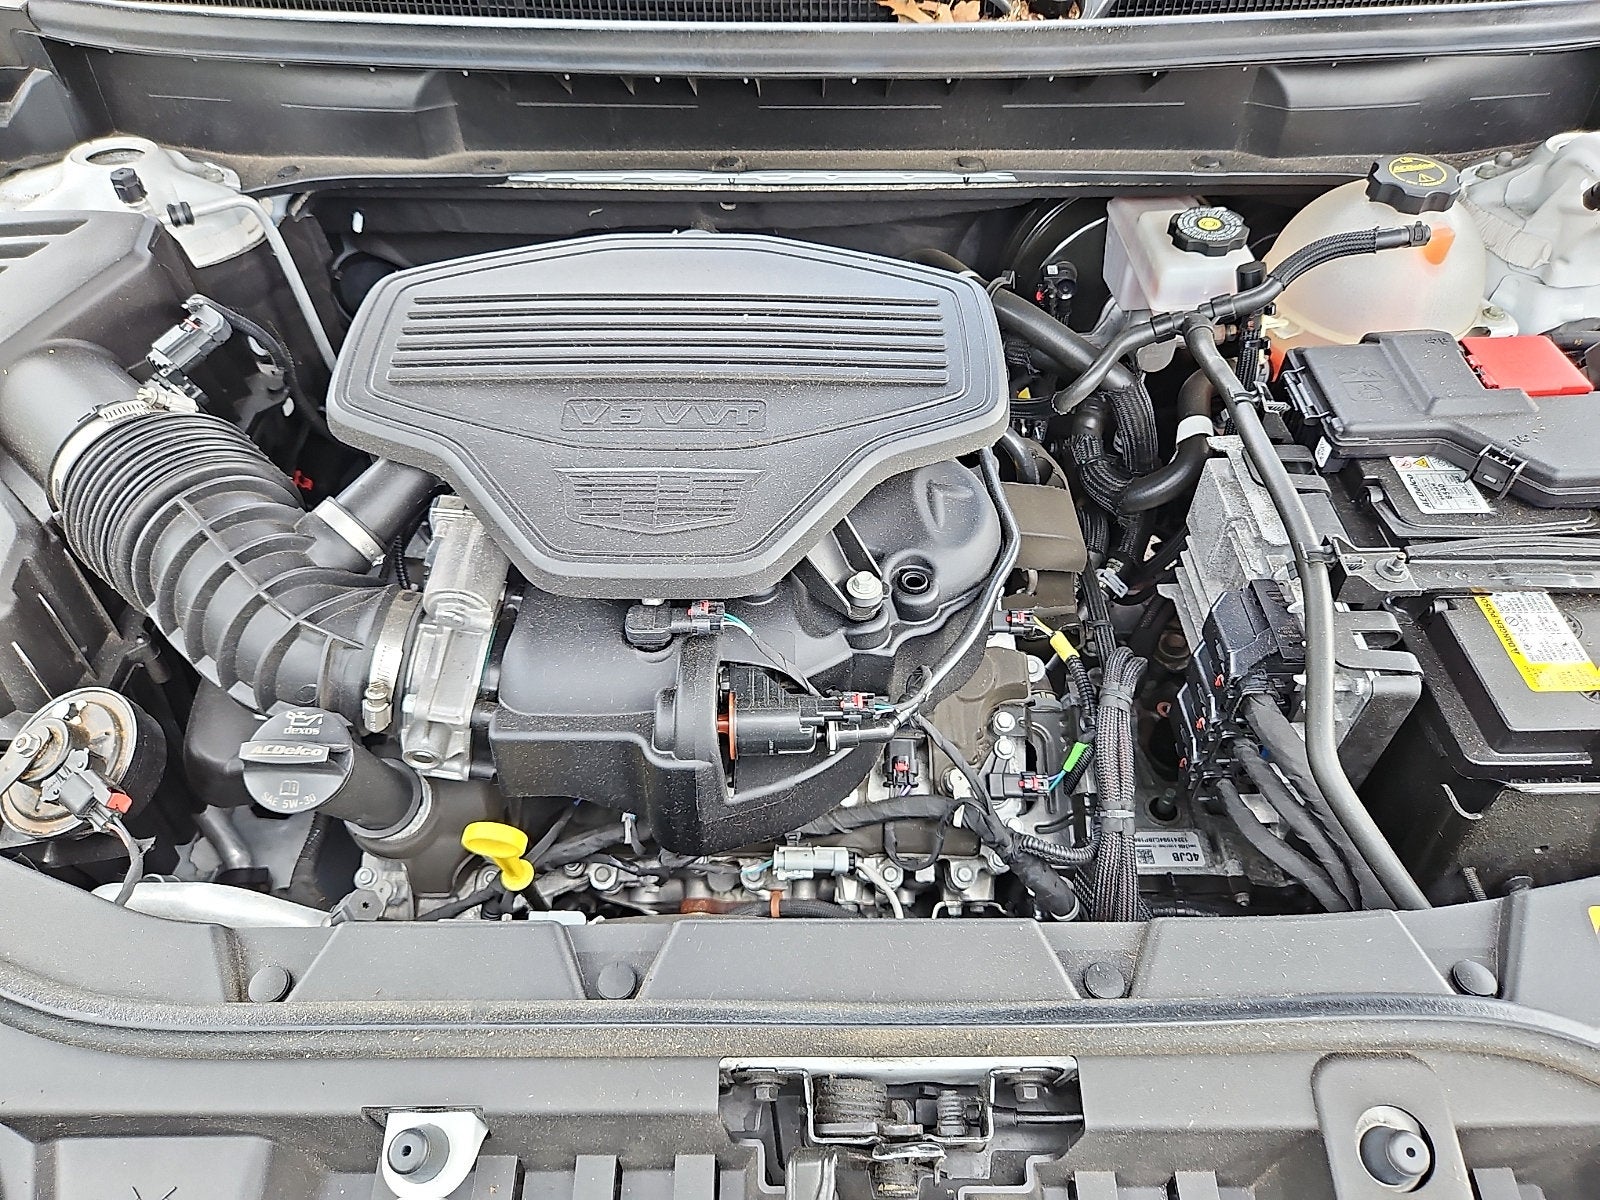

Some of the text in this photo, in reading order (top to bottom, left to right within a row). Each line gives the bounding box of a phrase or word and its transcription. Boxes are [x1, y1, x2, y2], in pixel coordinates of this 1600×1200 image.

[570, 403, 761, 426] V6 VVT
[1478, 596, 1516, 648] DANGER POISO
[283, 726, 320, 735] dexos
[250, 744, 323, 756] ACDelco
[262, 792, 316, 808] SAE 5W-30
[1172, 853, 1199, 862] 4CJB
